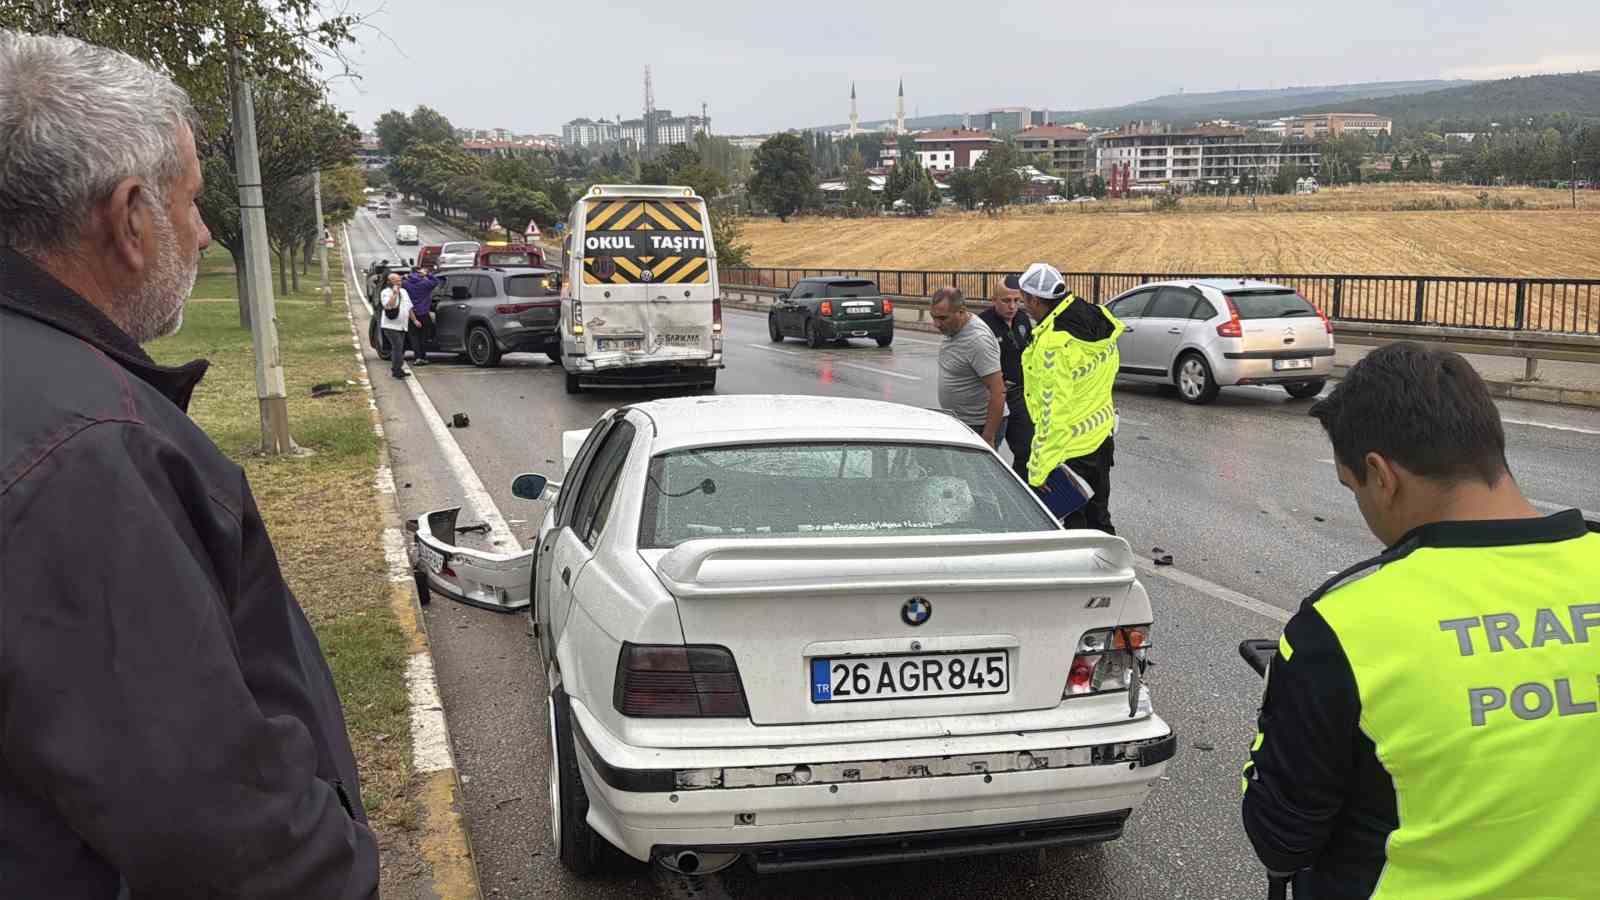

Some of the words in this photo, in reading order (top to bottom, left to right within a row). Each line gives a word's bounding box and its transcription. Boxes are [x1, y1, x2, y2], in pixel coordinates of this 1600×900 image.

[586, 236, 635, 250] OKUL
[650, 236, 704, 253] TAŞITI
[816, 683, 831, 693] TR
[1468, 673, 1600, 727] POL
